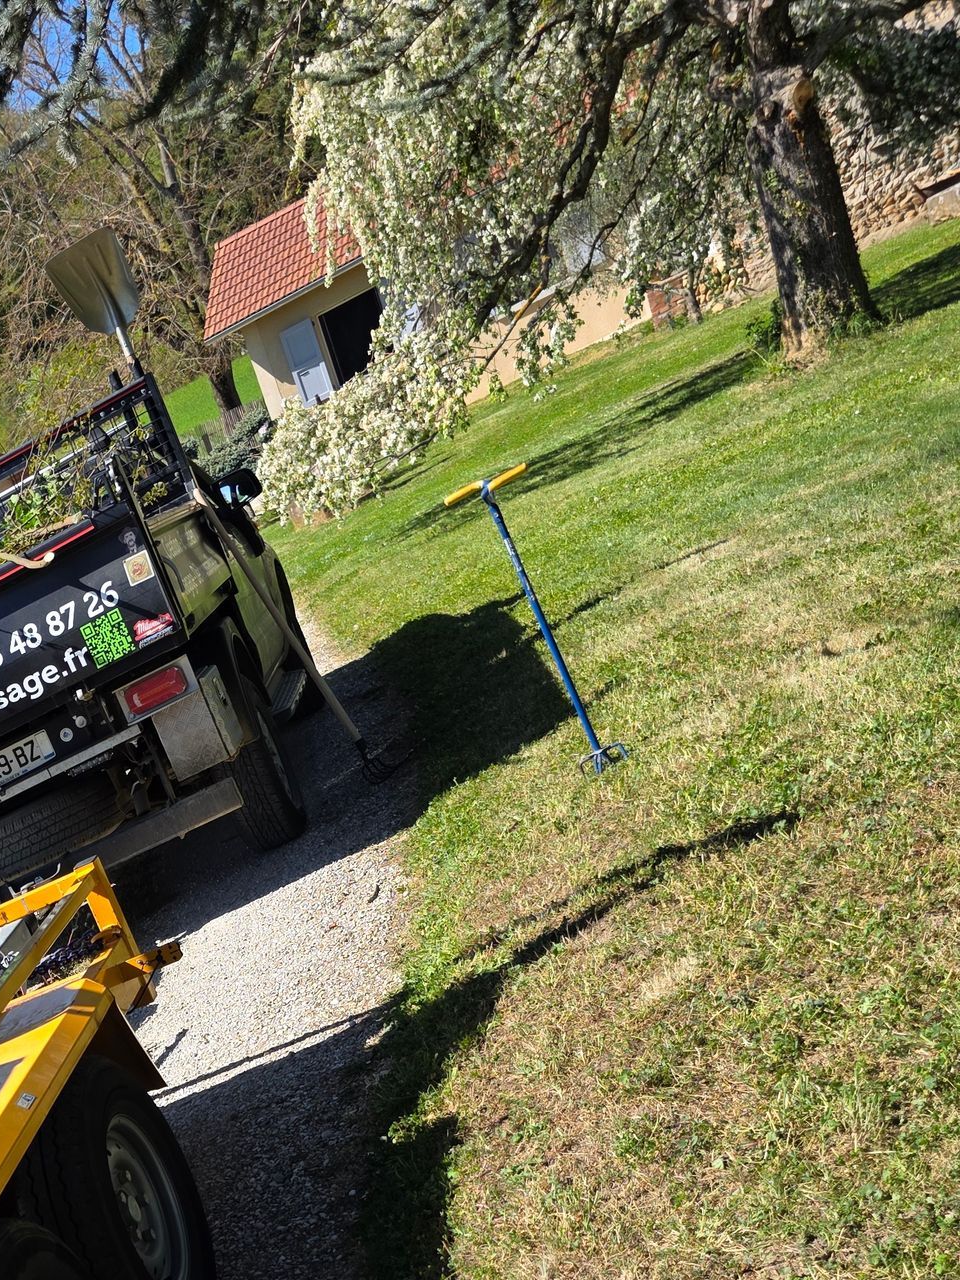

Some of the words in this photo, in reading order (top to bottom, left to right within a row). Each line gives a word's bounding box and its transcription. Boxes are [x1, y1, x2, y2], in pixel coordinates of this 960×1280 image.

[9, 623, 42, 656] 48
[45, 601, 76, 637] 87
[83, 580, 119, 618] 26
